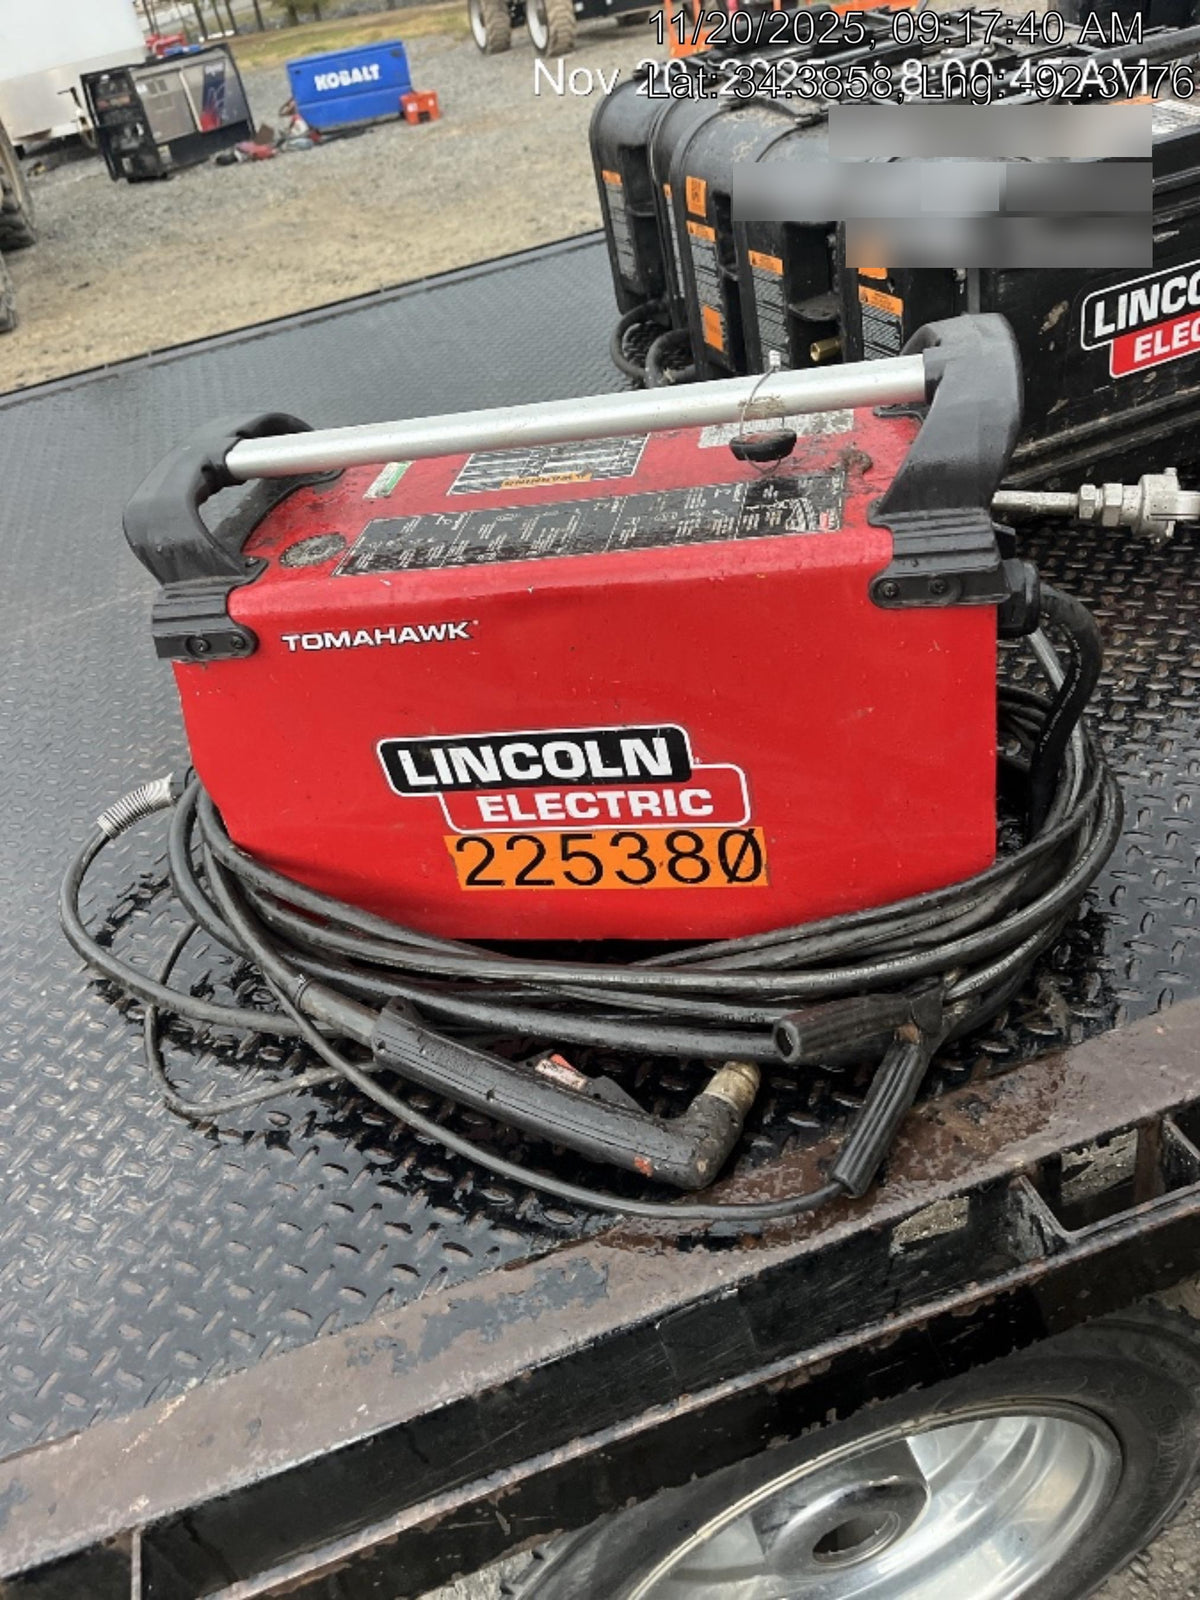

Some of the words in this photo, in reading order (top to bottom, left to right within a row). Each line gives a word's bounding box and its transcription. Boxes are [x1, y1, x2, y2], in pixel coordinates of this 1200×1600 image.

[313, 63, 381, 92] KOBALT
[280, 620, 471, 652] TOMAHAWK
[396, 736, 675, 788] LINCOLN
[475, 787, 715, 824] ELECTRIC
[454, 827, 765, 888] 225380
